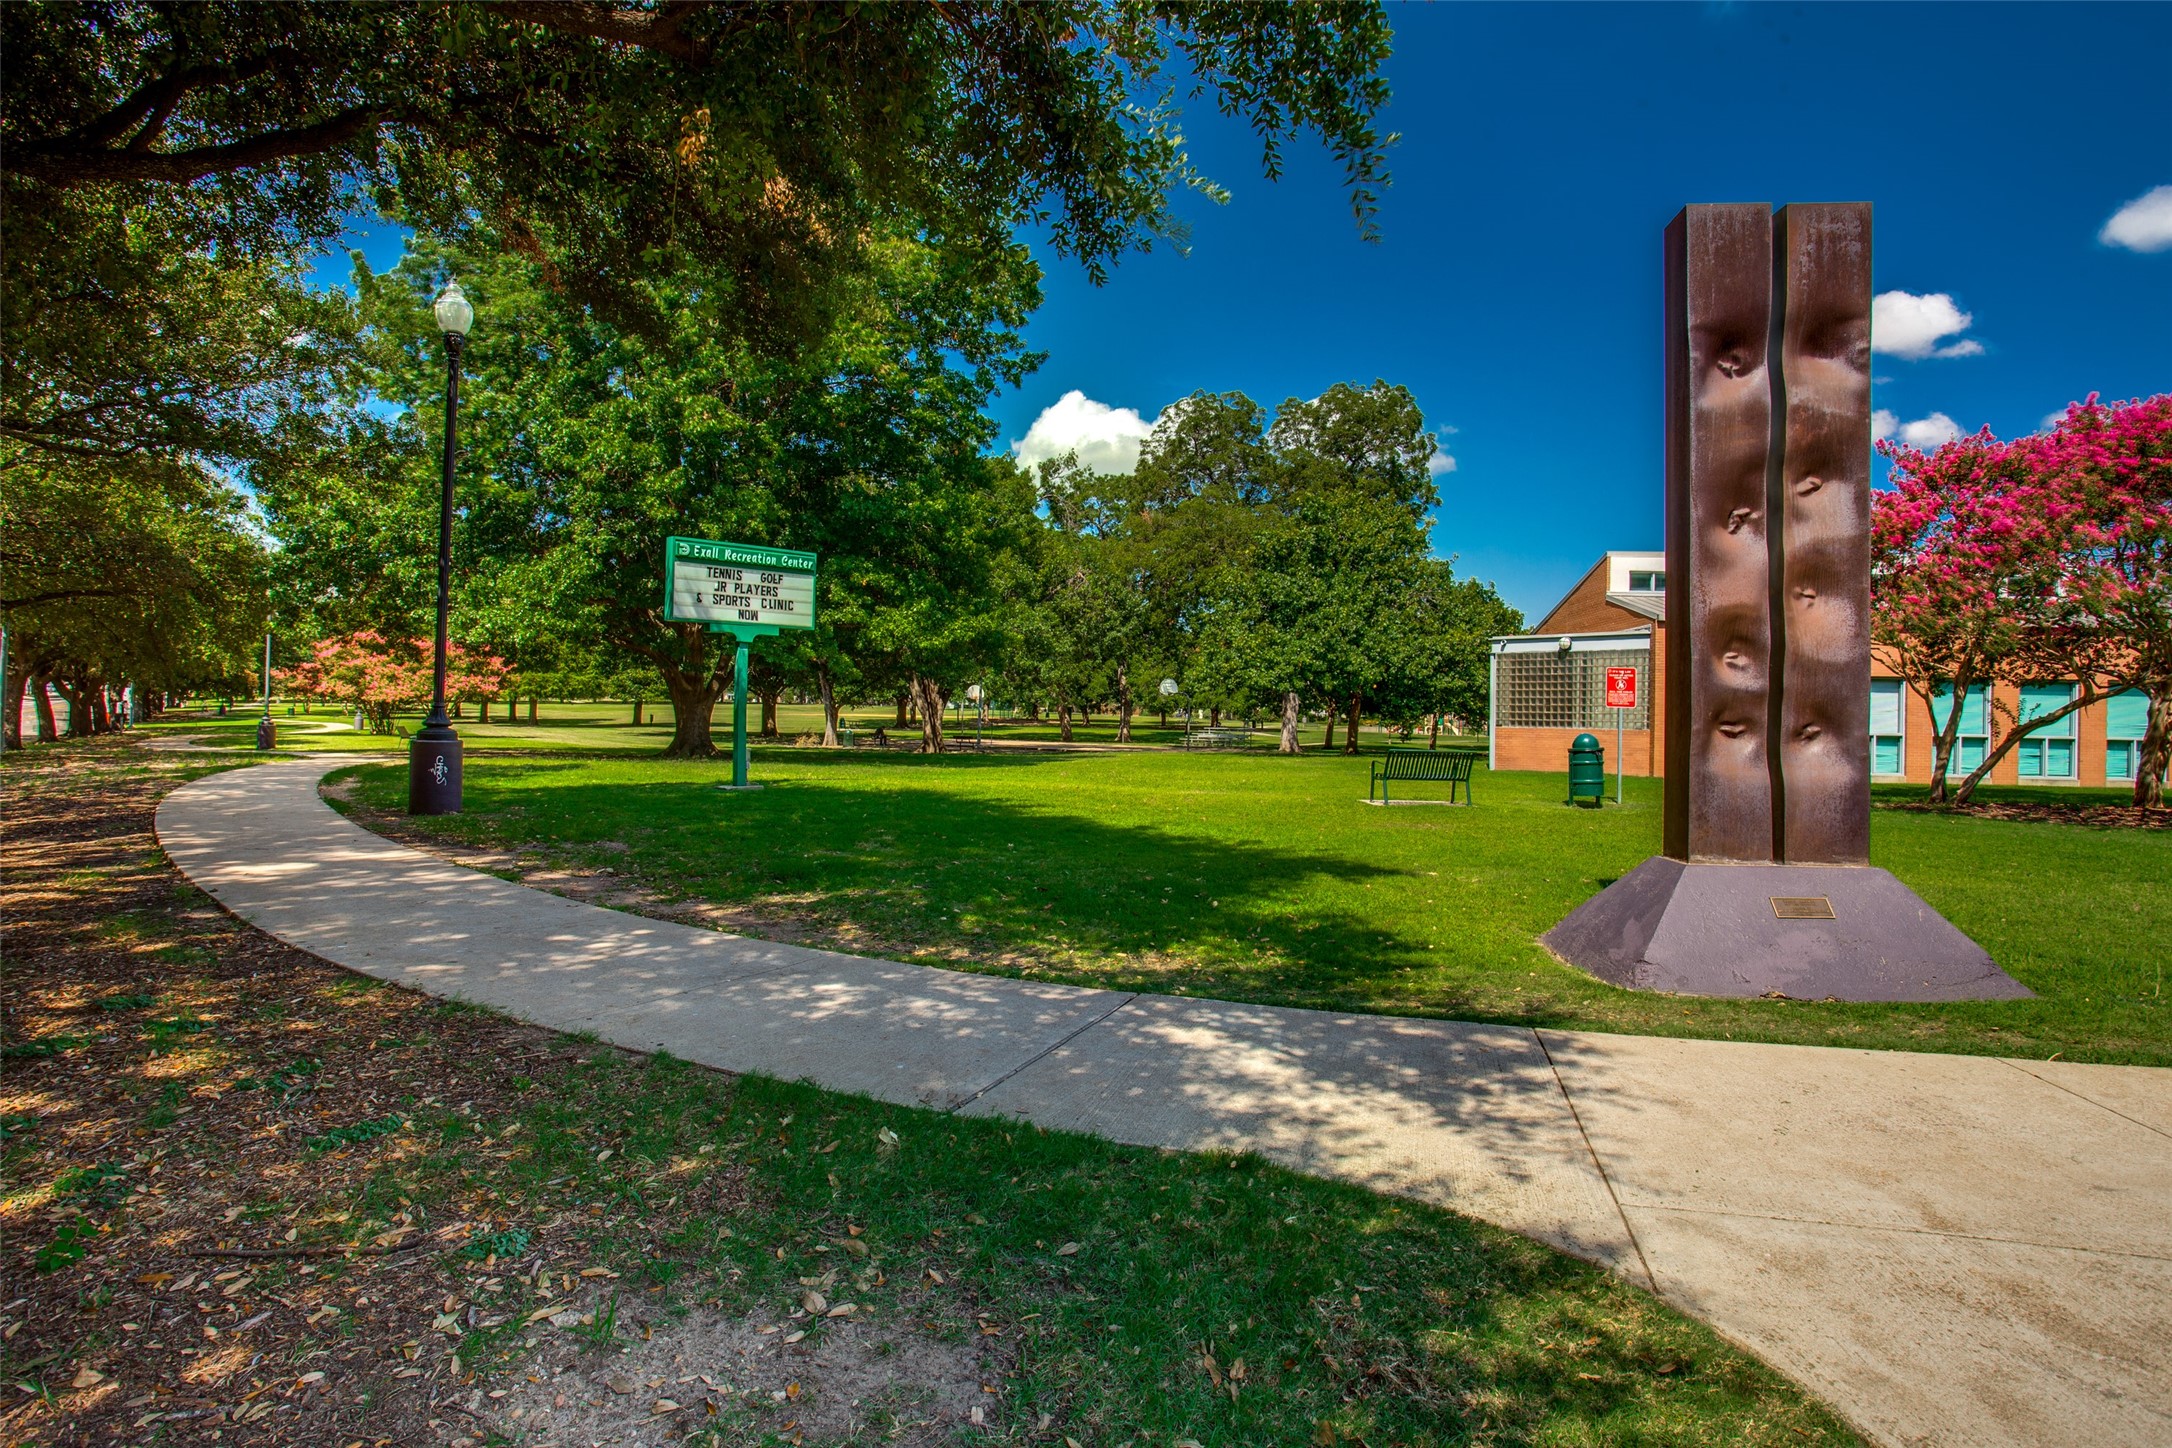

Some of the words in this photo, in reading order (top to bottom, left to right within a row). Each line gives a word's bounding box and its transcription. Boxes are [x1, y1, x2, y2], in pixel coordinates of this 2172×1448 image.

[694, 545, 719, 559] Exall
[724, 549, 777, 565] Recreation
[781, 555, 813, 569] Center
[707, 567, 742, 581] TENNIS
[761, 573, 783, 584] GOLF
[714, 581, 726, 592] JR
[734, 583, 778, 597] PLAYERS
[697, 593, 702, 603] &
[713, 594, 750, 607] SPORTS
[761, 598, 794, 611] CLINIC
[738, 610, 758, 621] NOW
